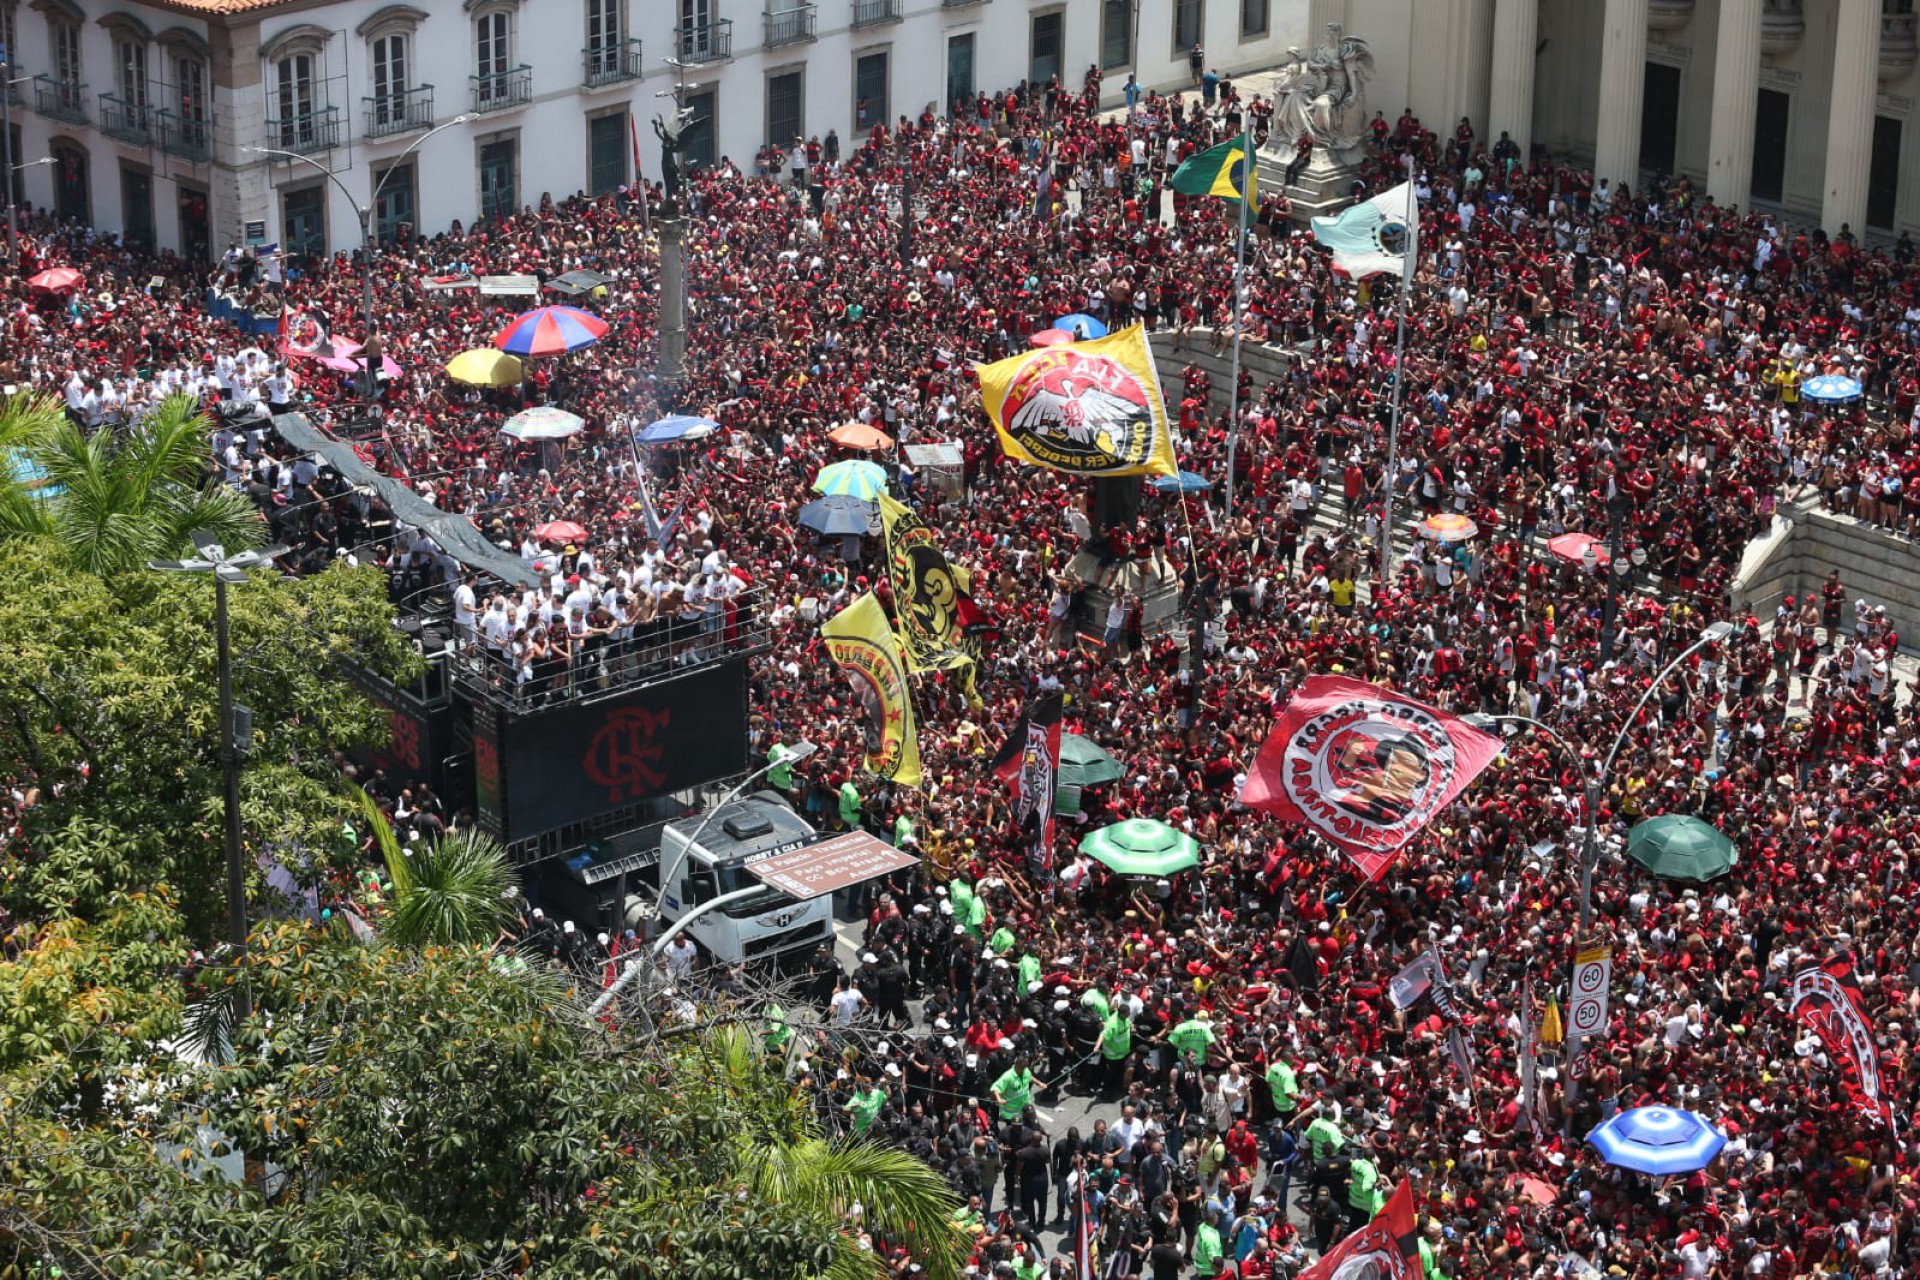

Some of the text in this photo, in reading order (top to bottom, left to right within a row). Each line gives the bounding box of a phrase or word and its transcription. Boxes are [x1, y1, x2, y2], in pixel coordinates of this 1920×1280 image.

[813, 836, 868, 853] Tiradentes
[743, 849, 772, 864] HOBBY
[774, 848, 782, 856] &
[782, 843, 797, 852] CIA
[824, 849, 872, 865] Imperial
[805, 874, 823, 882] CC
[1583, 968, 1599, 983] 60
[1580, 1005, 1596, 1020] 50
